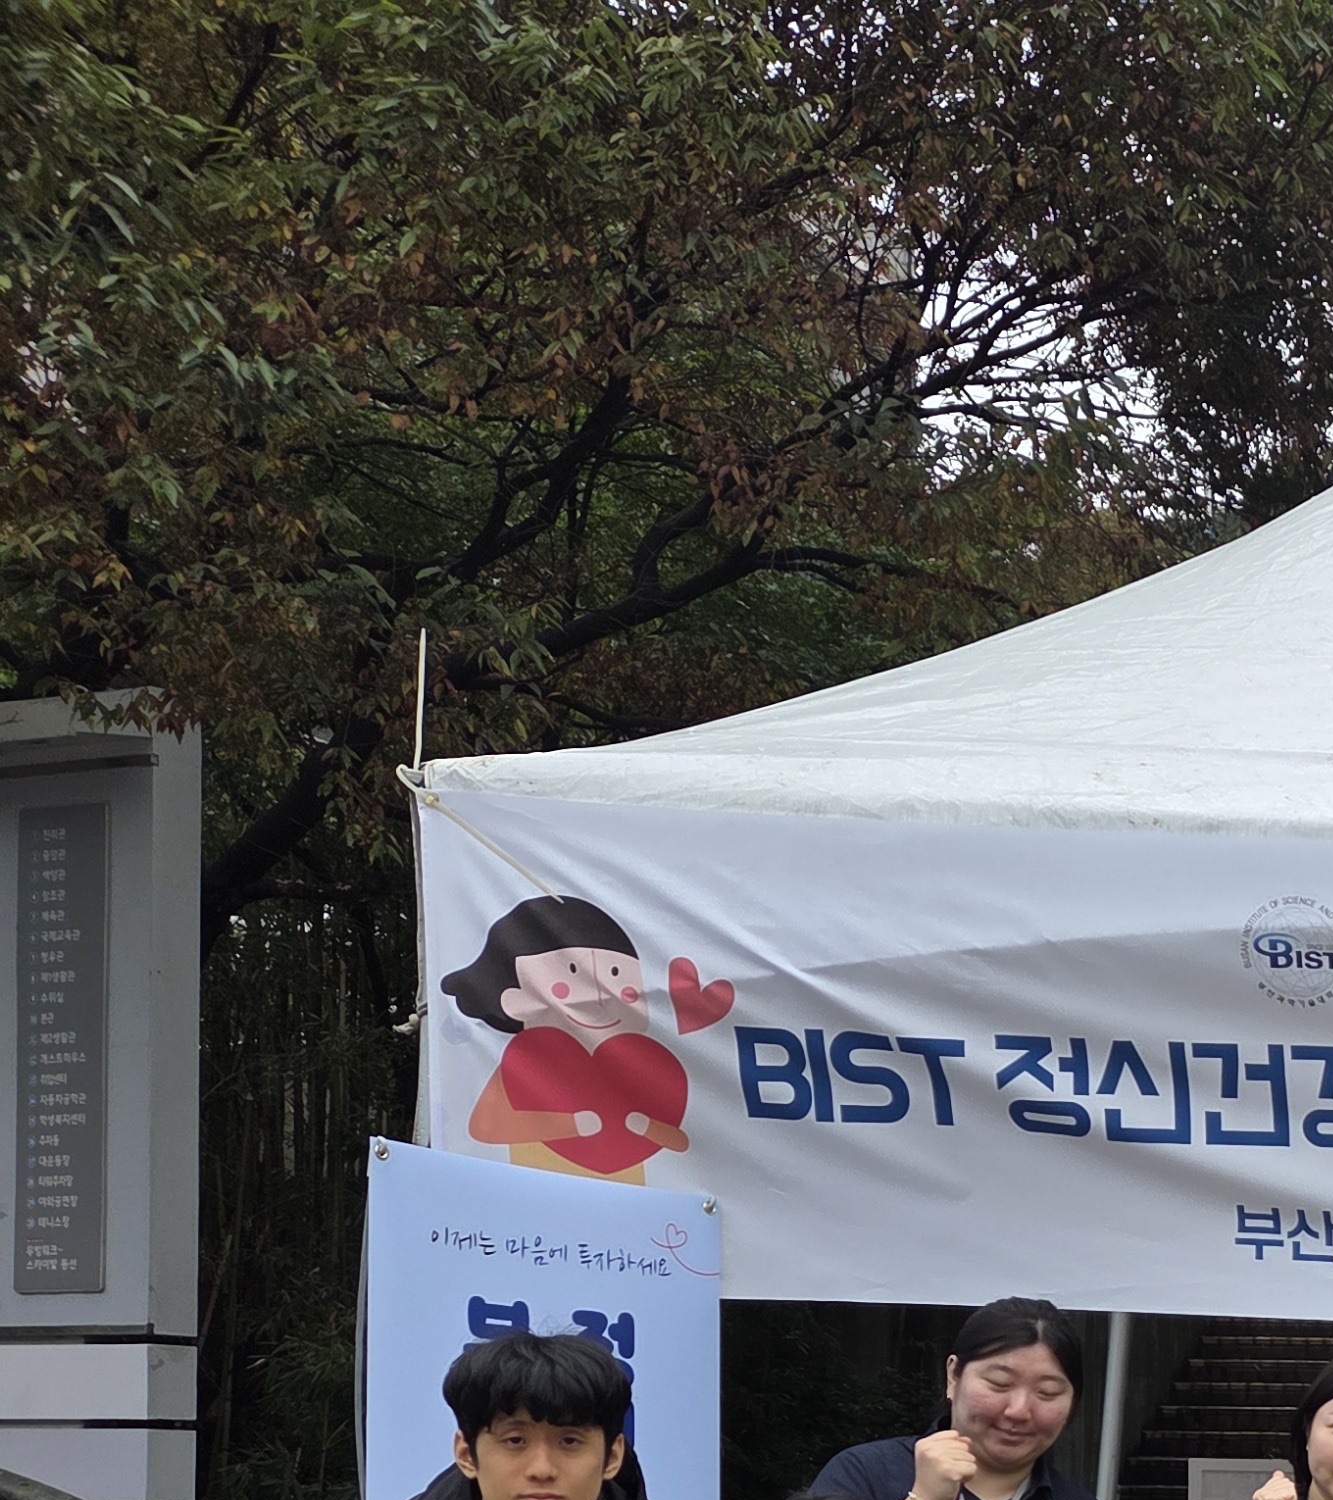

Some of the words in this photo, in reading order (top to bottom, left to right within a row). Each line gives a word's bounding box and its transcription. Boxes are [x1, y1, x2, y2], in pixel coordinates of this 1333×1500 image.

[733, 1025, 966, 1127] BIST
[430, 1227, 496, 1257] 이제는
[505, 1236, 569, 1267] 마음에
[577, 1243, 672, 1277] 투자하세요
